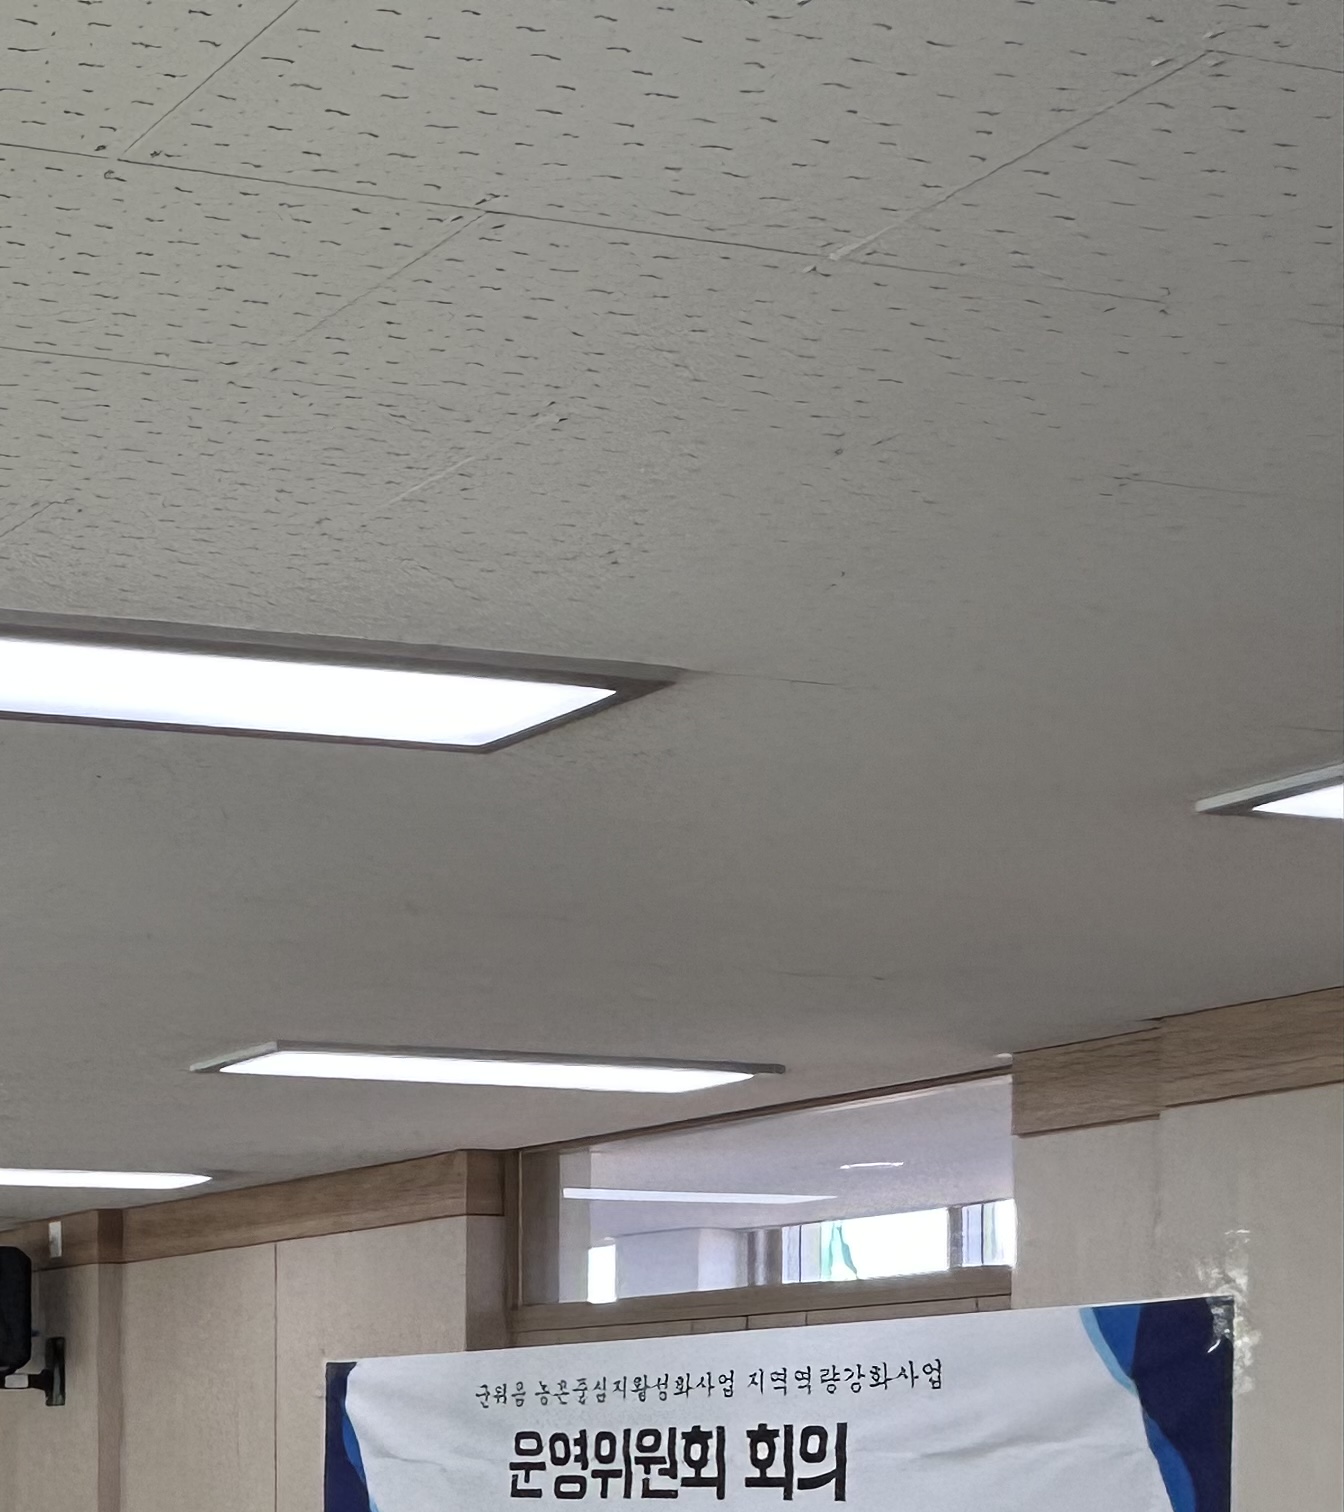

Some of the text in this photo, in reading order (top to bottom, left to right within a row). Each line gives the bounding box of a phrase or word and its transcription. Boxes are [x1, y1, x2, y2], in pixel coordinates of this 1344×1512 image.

[747, 1358, 942, 1396] 지역역량강화사업
[509, 1422, 847, 1502] 운영위원회 회의
